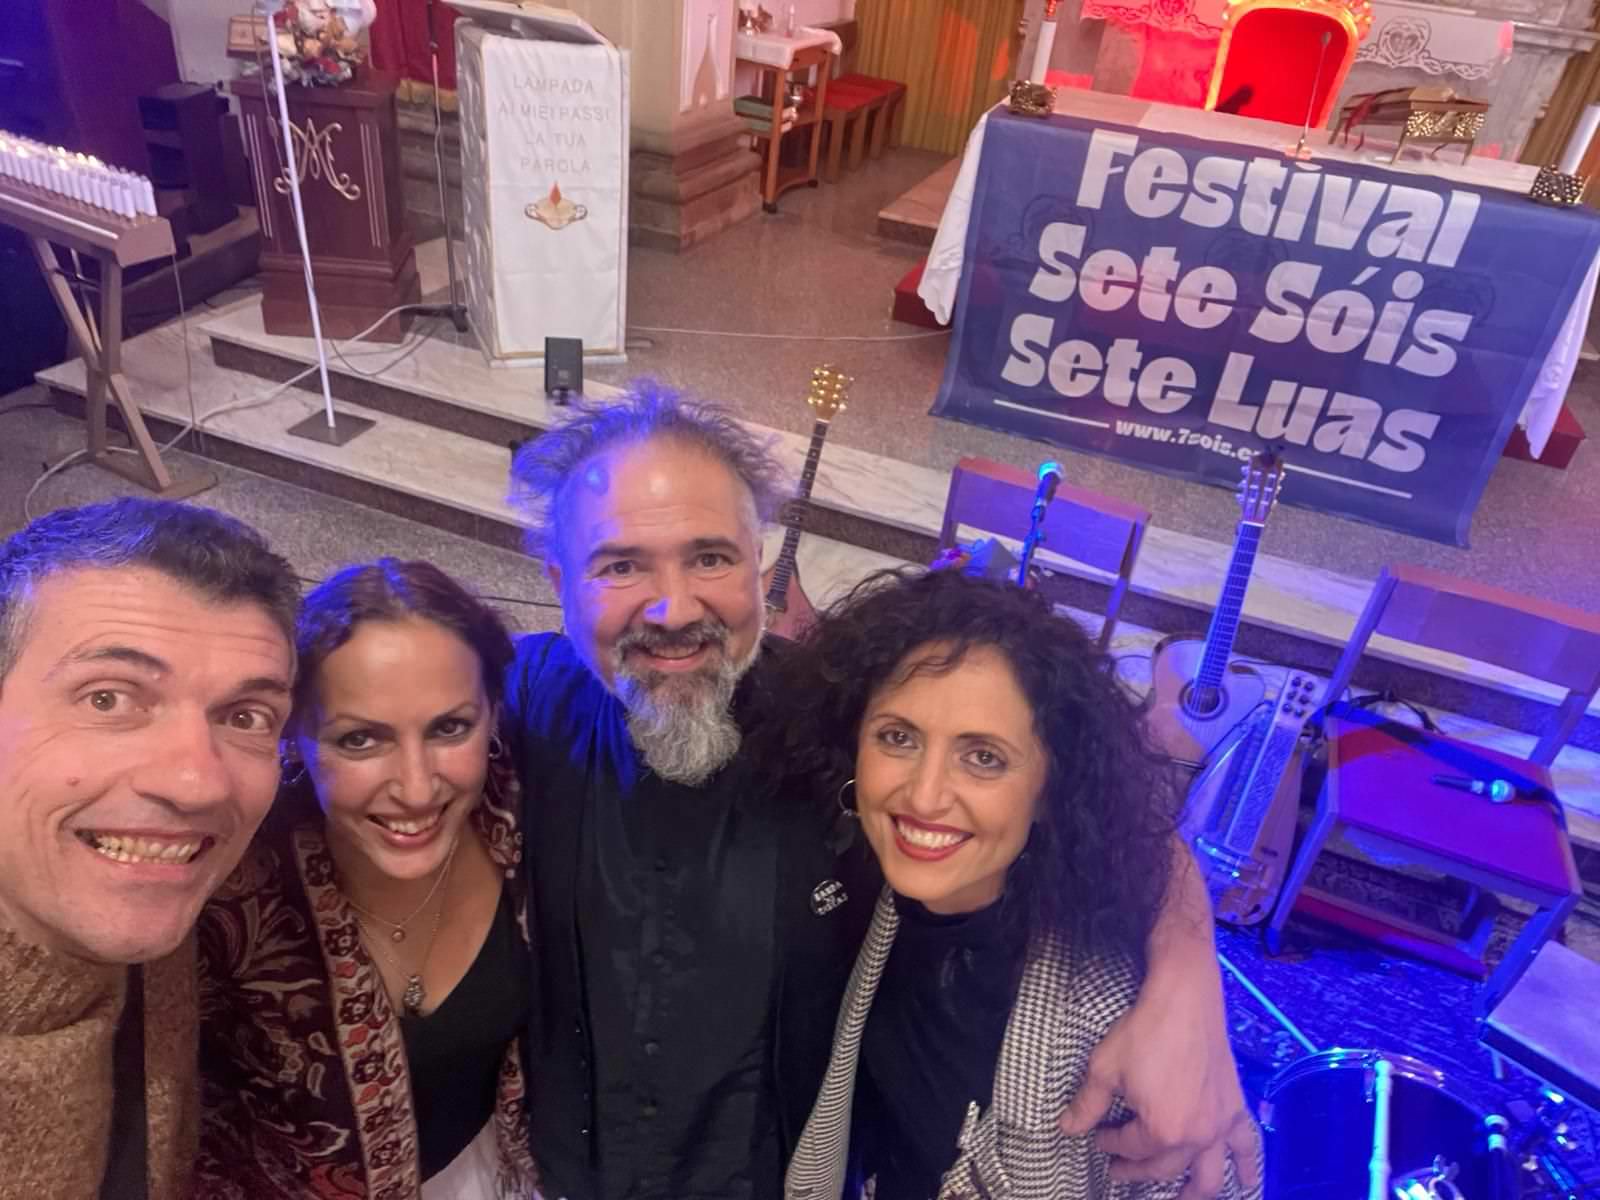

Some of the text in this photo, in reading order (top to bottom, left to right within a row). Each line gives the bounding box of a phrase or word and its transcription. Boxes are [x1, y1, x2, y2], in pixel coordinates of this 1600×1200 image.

[513, 74, 595, 94] LAMPADA
[499, 101, 609, 121] AI MIEI PASSI
[525, 131, 587, 147] LA TUA
[519, 157, 592, 174] PAROLA
[1077, 128, 1481, 268] Festival
[1029, 222, 1473, 378] Sete Sóis
[1001, 313, 1441, 472] Sete Luas
